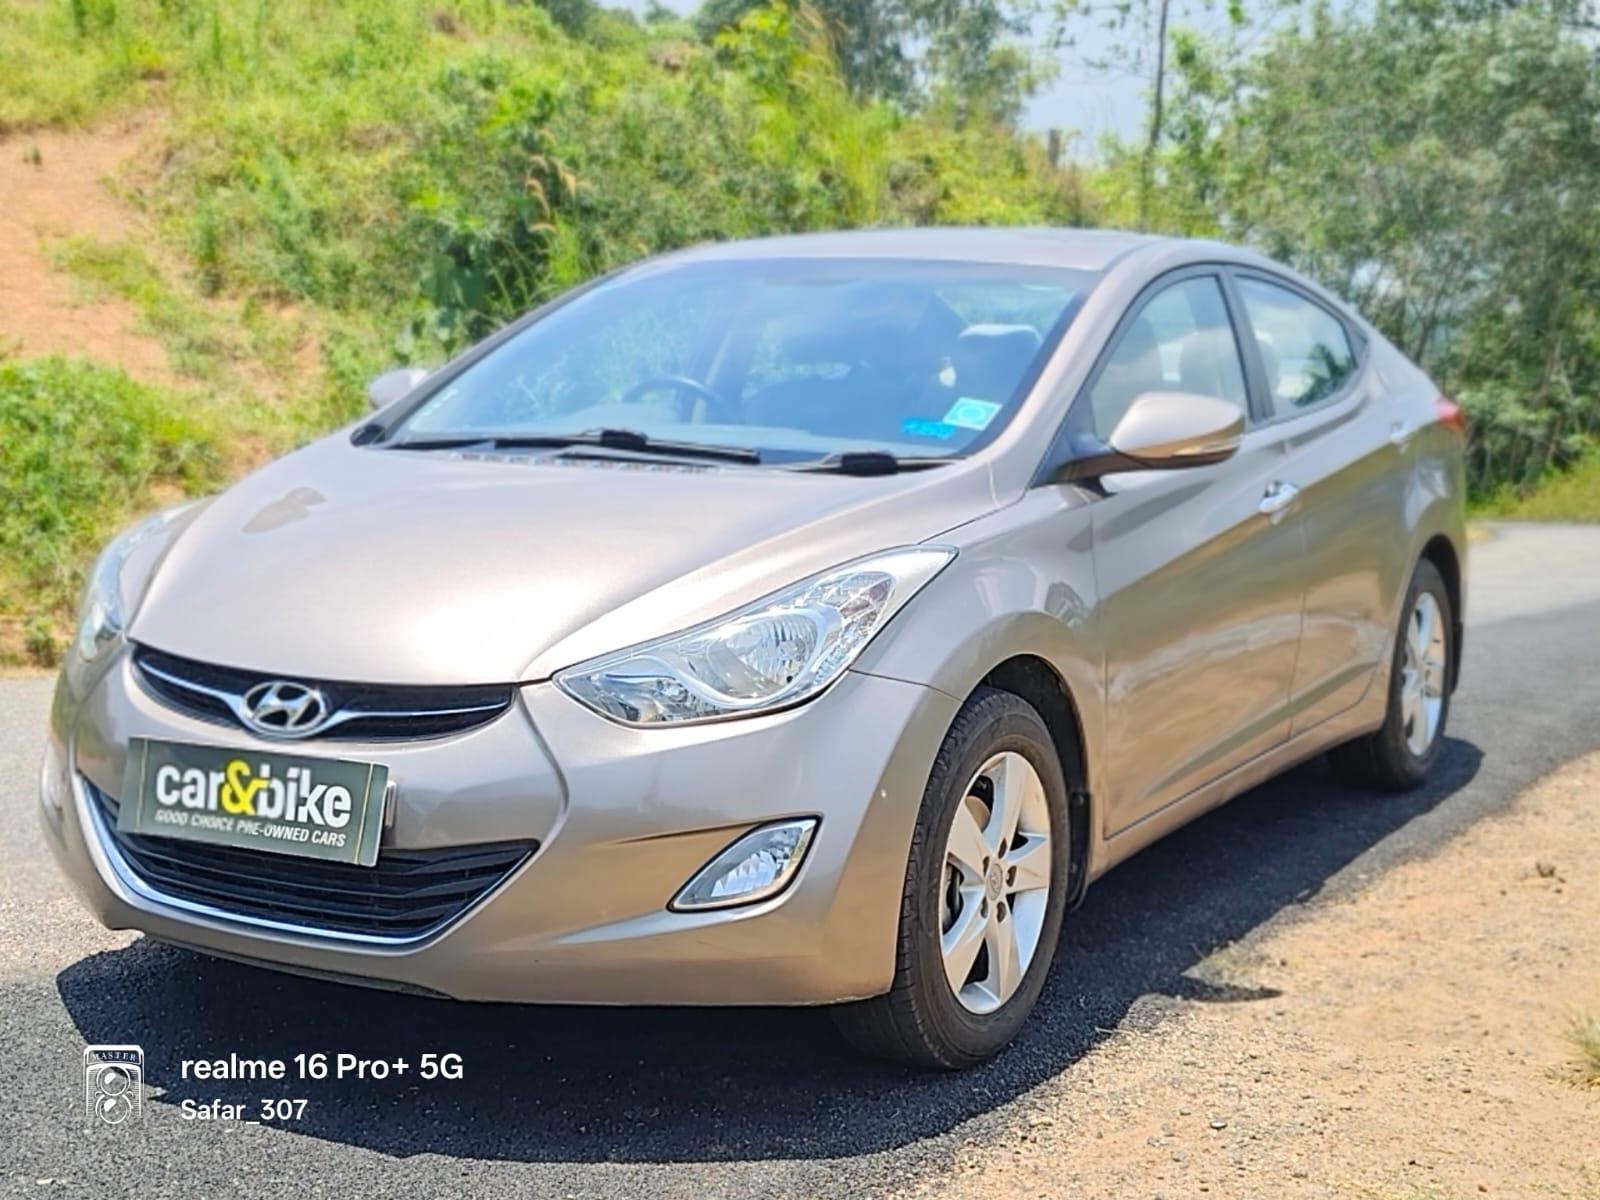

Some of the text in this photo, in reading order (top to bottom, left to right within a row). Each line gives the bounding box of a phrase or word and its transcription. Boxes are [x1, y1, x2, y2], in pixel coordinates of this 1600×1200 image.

[156, 759, 351, 828] car&bike
[155, 809, 347, 848] GOOD CHOICE PRE-OWNED CARS
